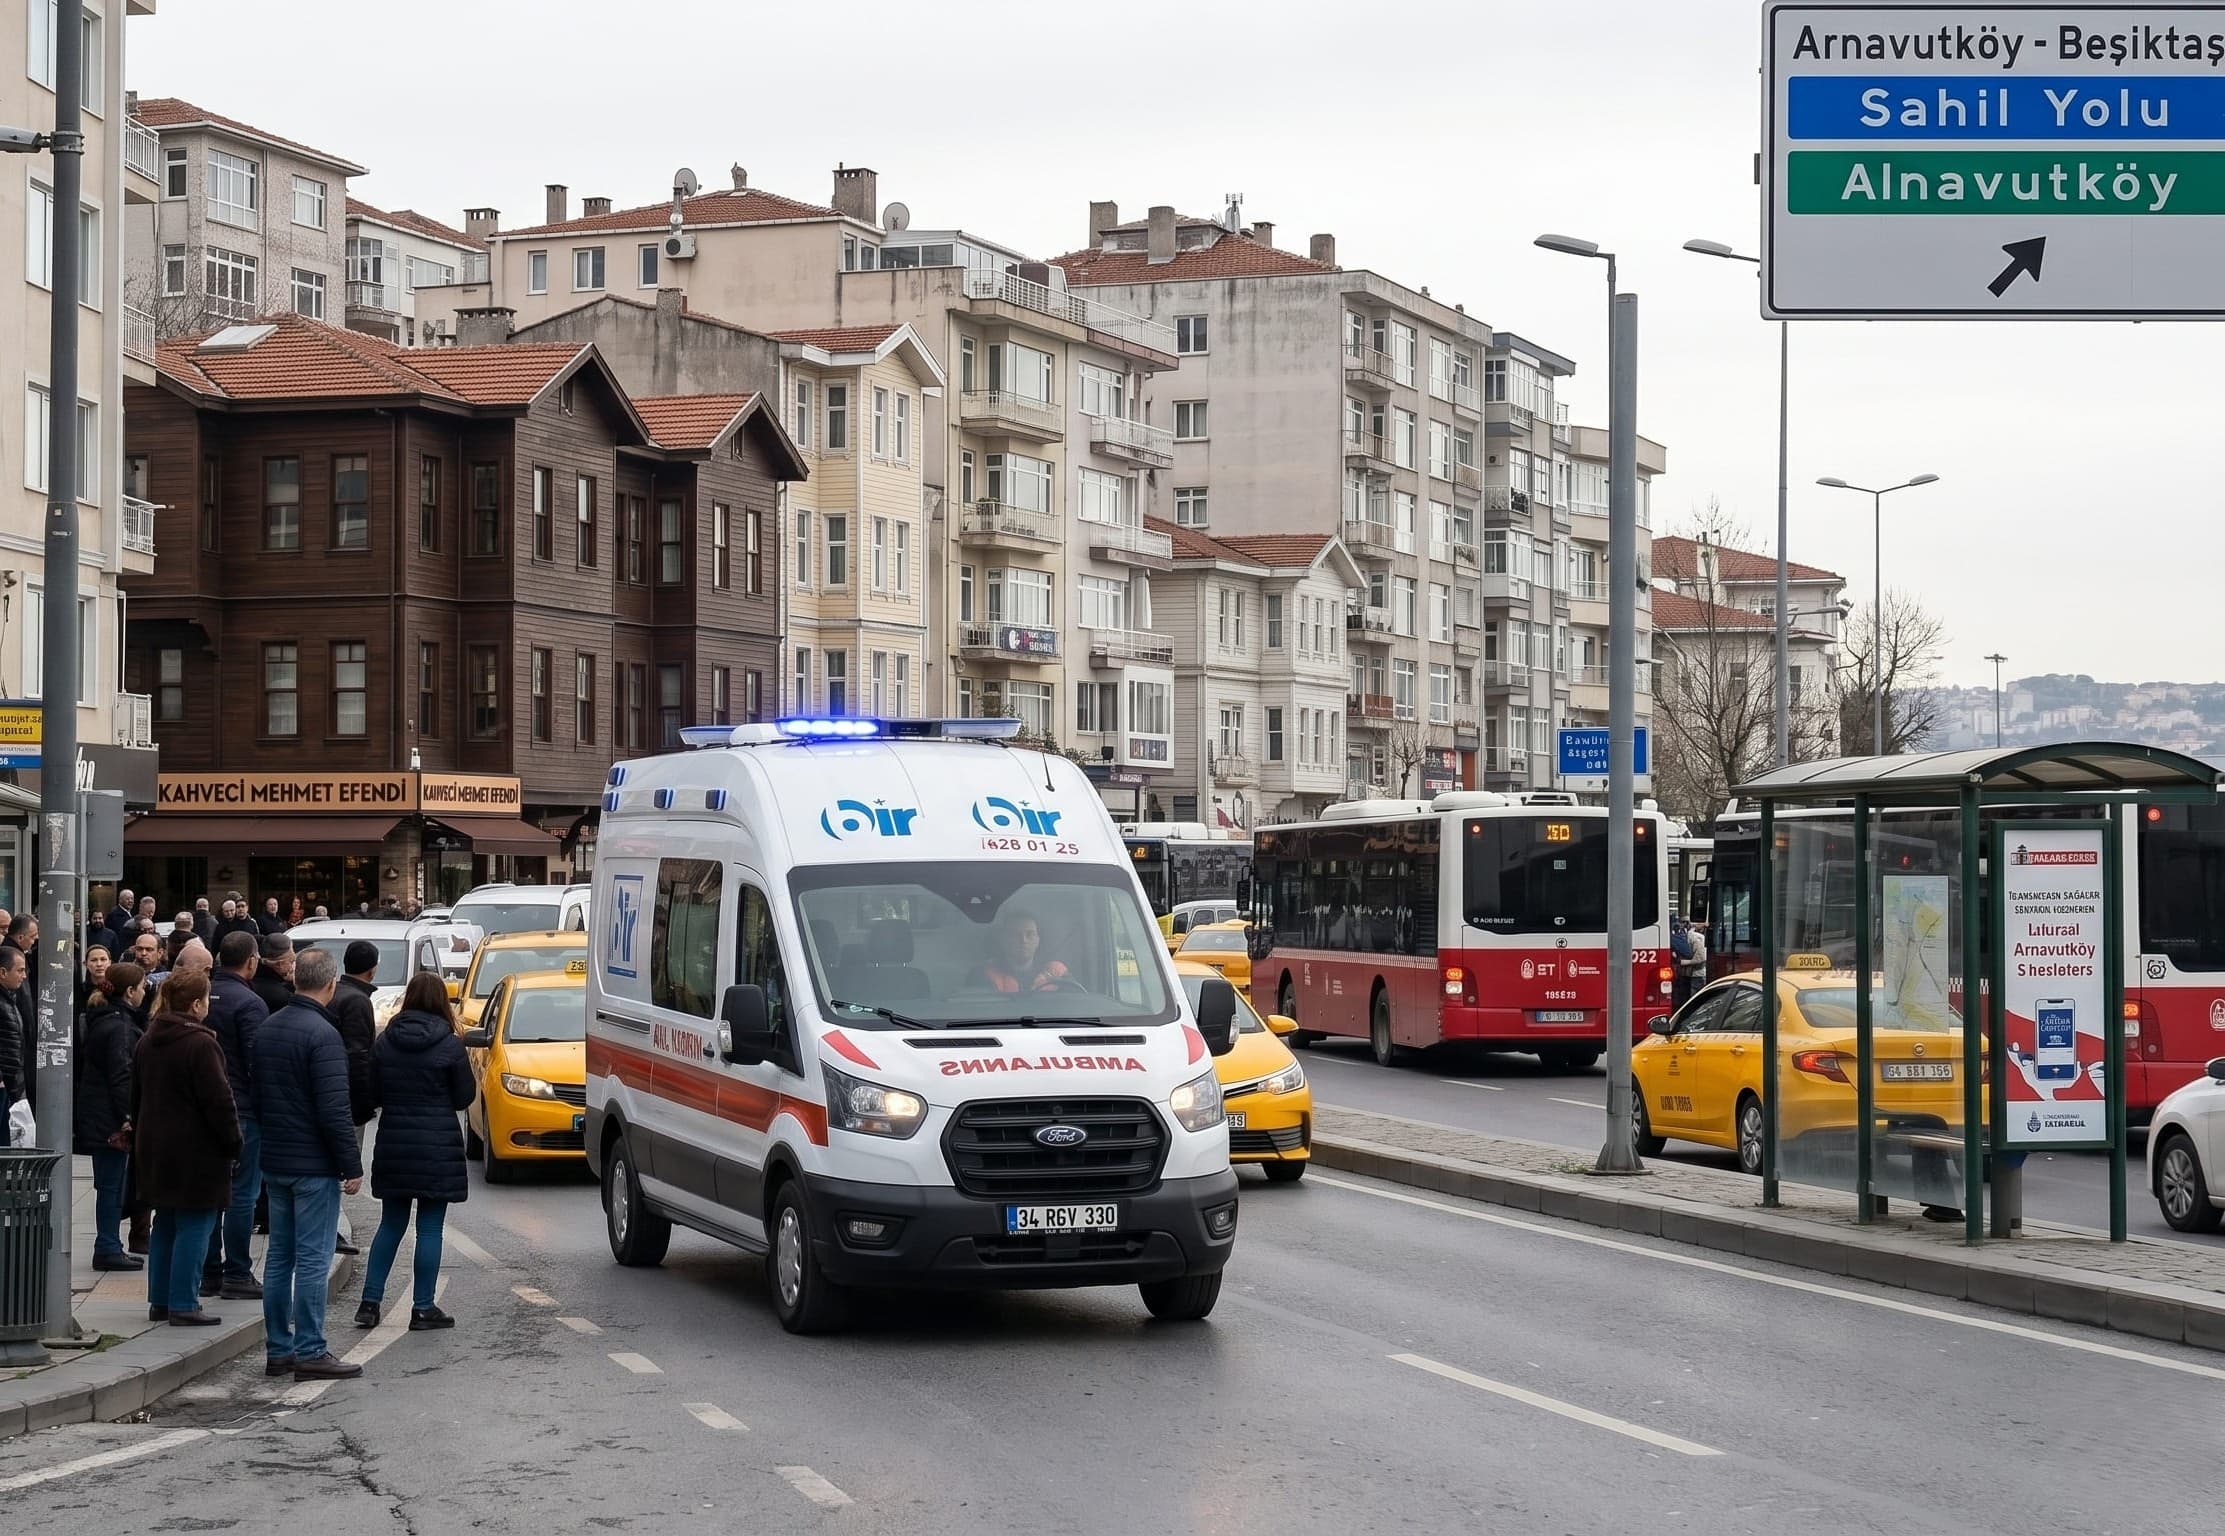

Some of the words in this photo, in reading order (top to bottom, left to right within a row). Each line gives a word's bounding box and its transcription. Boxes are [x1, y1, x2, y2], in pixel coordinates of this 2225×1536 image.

[1793, 25, 2024, 69] Arnavutköy
[2058, 25, 2225, 67] Beşiktaş
[1860, 88, 2008, 127] Sahil
[2044, 88, 2169, 127] Yolu
[1841, 162, 2178, 212] Alnavutköy
[159, 778, 245, 803] KAHVECİ
[250, 783, 332, 803] MEHMET
[339, 778, 407, 802] EFENDİ
[2014, 942, 2096, 959] Arnavutköy
[1018, 1208, 1039, 1228] 34
[1046, 1207, 1077, 1227] RGV
[1084, 1206, 1115, 1226] 330
